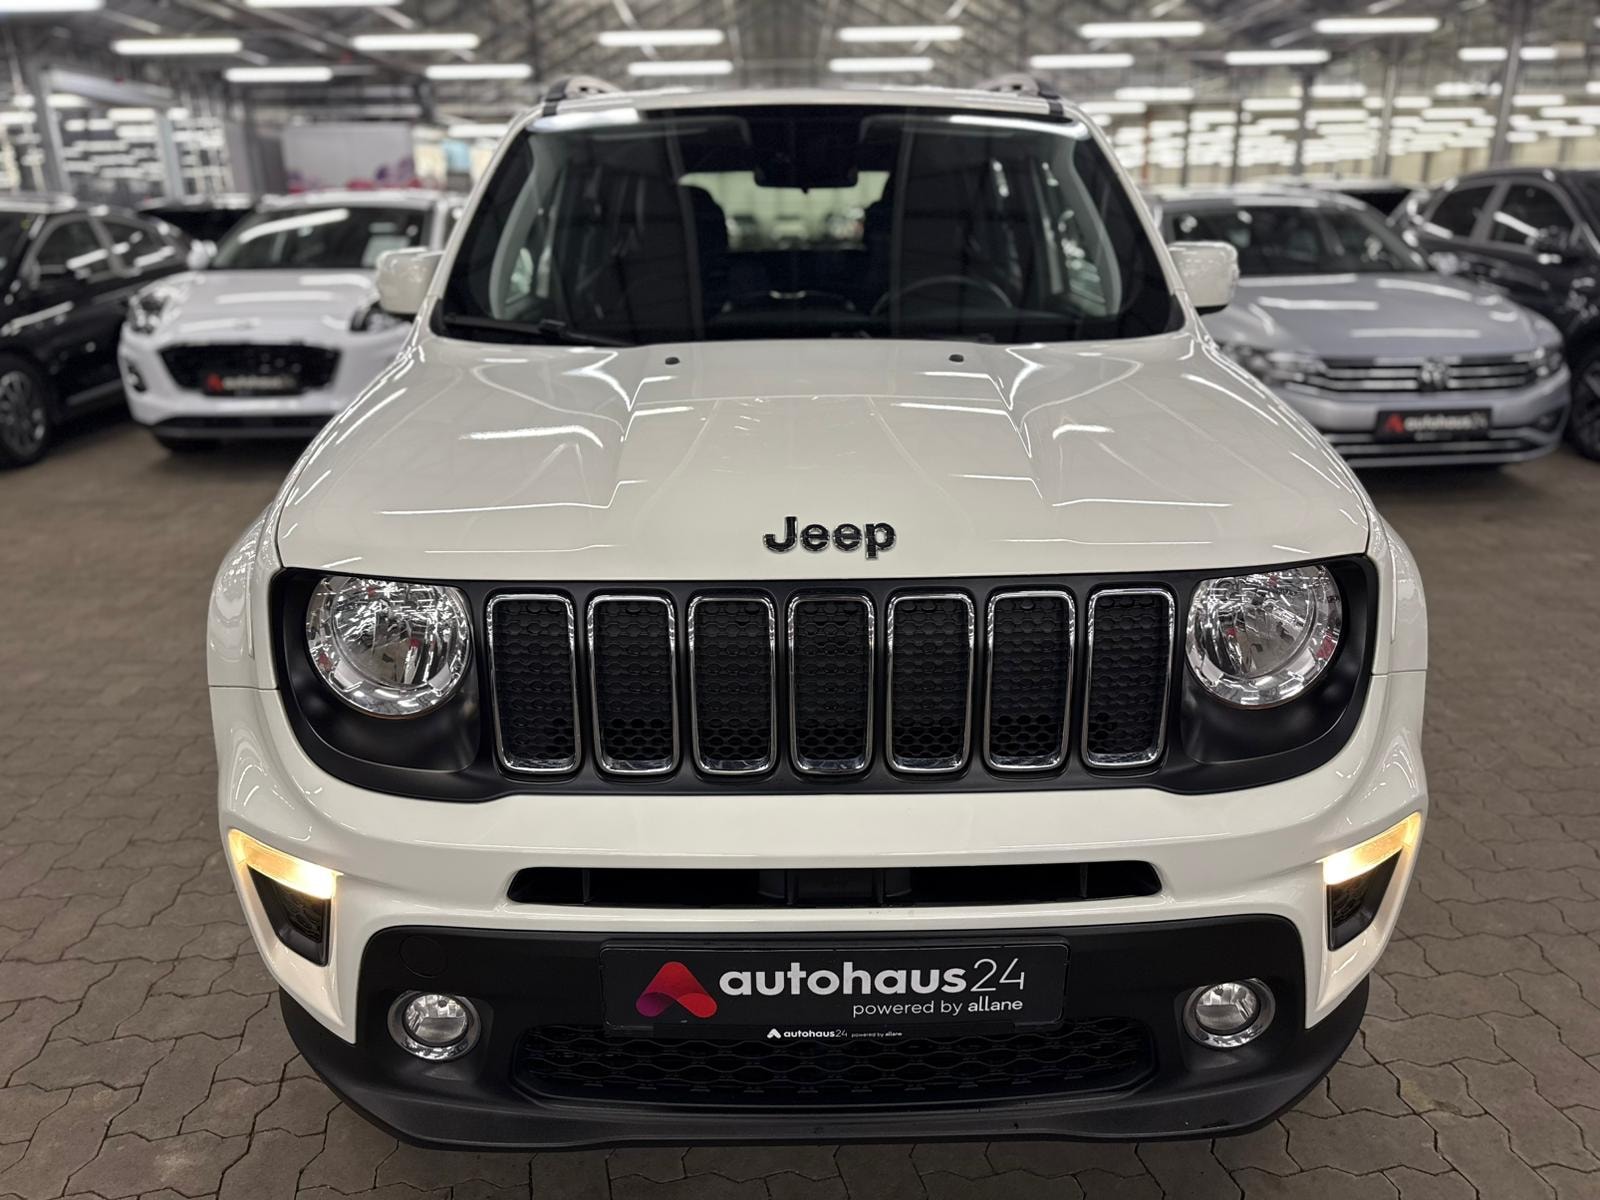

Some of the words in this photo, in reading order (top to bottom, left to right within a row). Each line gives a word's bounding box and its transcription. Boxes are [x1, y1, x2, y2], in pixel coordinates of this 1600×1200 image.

[763, 516, 896, 560] Jeep
[719, 958, 1025, 995] autohaus24
[853, 1000, 934, 1018] powered
[940, 1000, 963, 1016] by
[968, 995, 1023, 1012] allane
[783, 1029, 848, 1038] autohaus24
